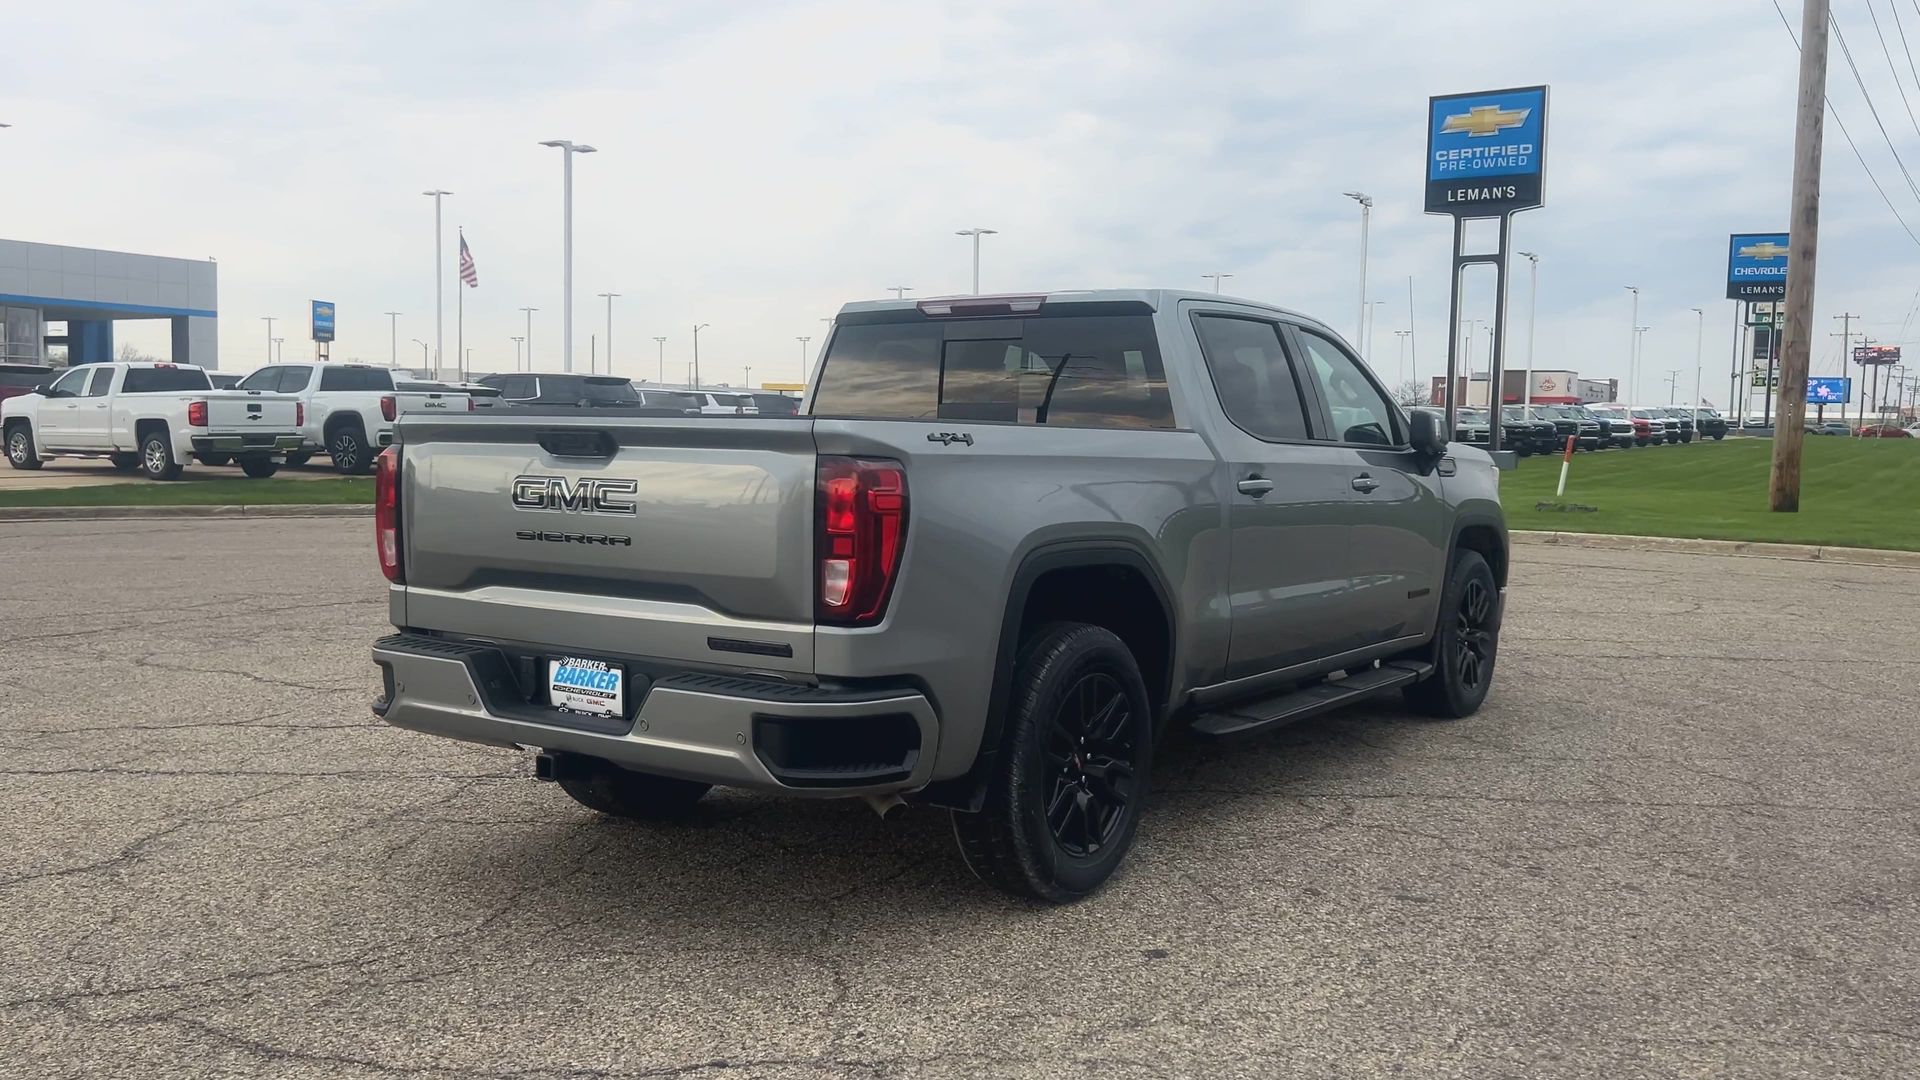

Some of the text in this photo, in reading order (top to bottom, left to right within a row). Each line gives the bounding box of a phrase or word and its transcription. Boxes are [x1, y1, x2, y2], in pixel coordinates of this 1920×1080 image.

[1435, 144, 1533, 161] CERTIFIED
[1440, 155, 1527, 171] PRE-OWNED
[1448, 186, 1516, 202] LEMAN'S
[1734, 267, 1787, 275] CHEVROLE
[1740, 286, 1784, 294] LEMAN'S
[512, 475, 638, 517] GMC
[516, 530, 632, 546] SIERRA
[568, 657, 606, 671] BARKER
[553, 665, 619, 691] BARKER
[565, 687, 614, 698] CHEVROLET
